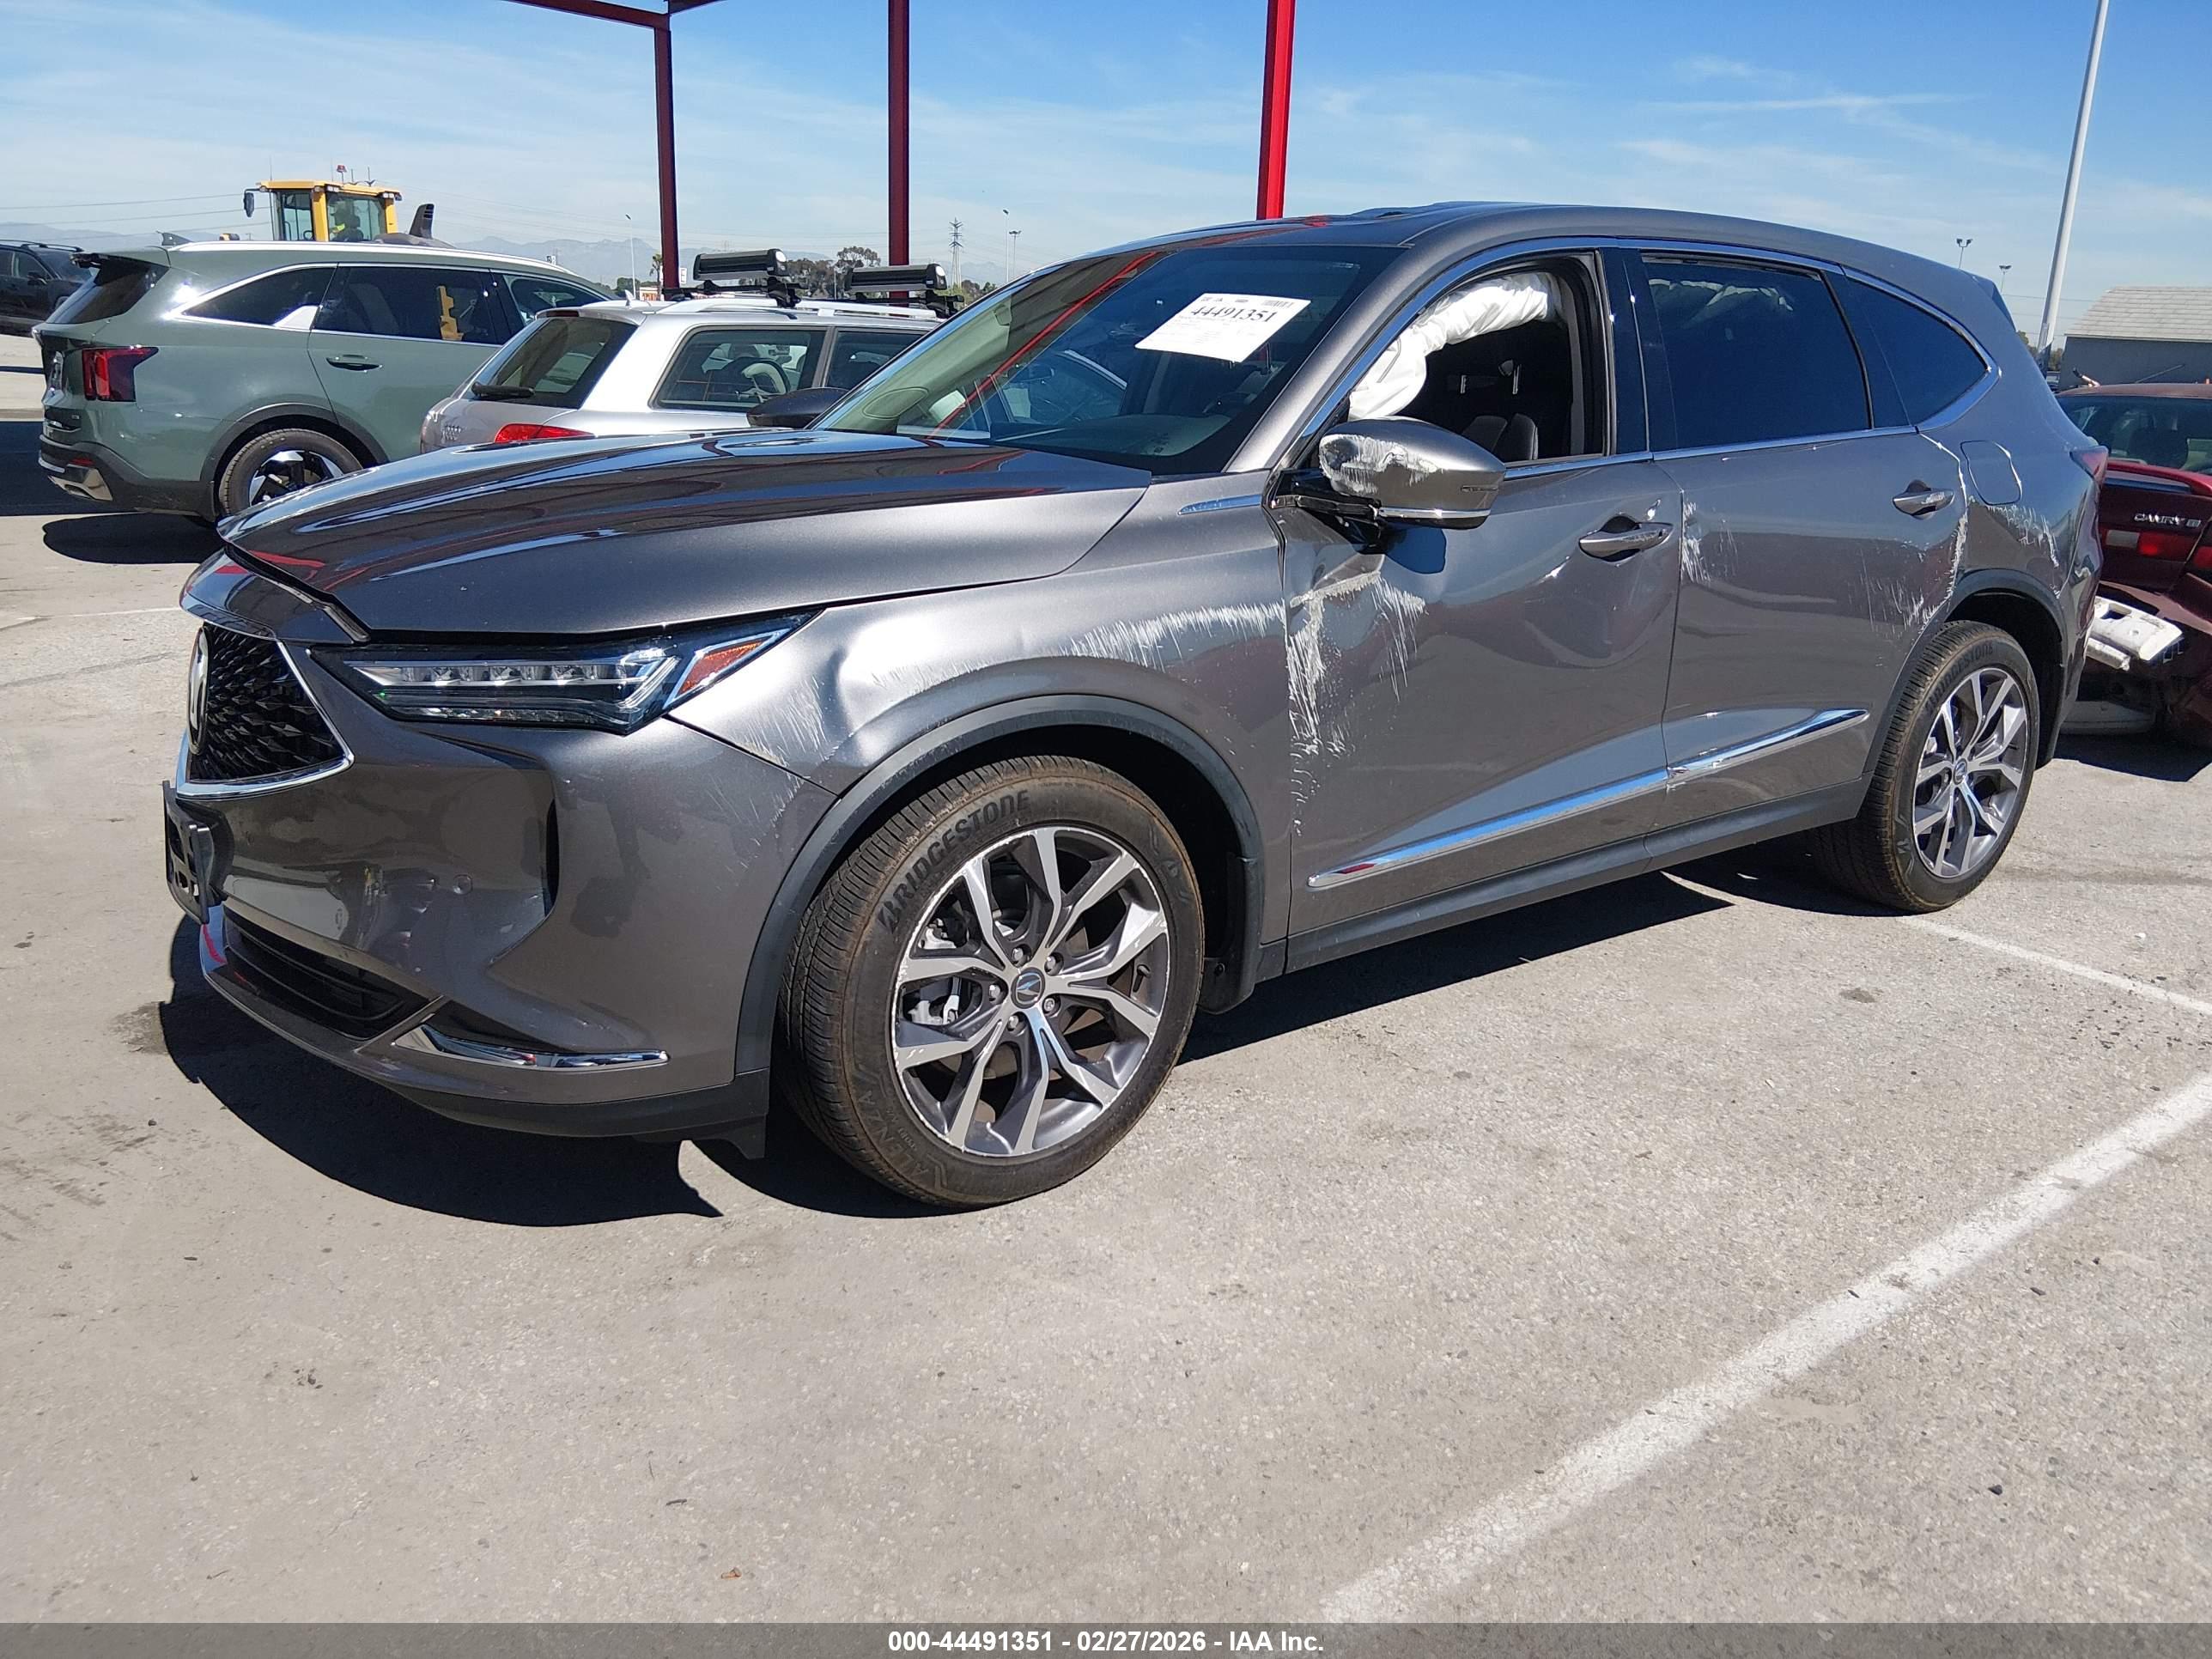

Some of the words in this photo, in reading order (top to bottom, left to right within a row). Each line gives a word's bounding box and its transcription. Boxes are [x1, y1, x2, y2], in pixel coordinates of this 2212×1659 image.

[1190, 305, 1278, 323] 44491351
[877, 788, 1031, 935] BRIDGESTONE
[859, 1090, 929, 1176] ALENZA
